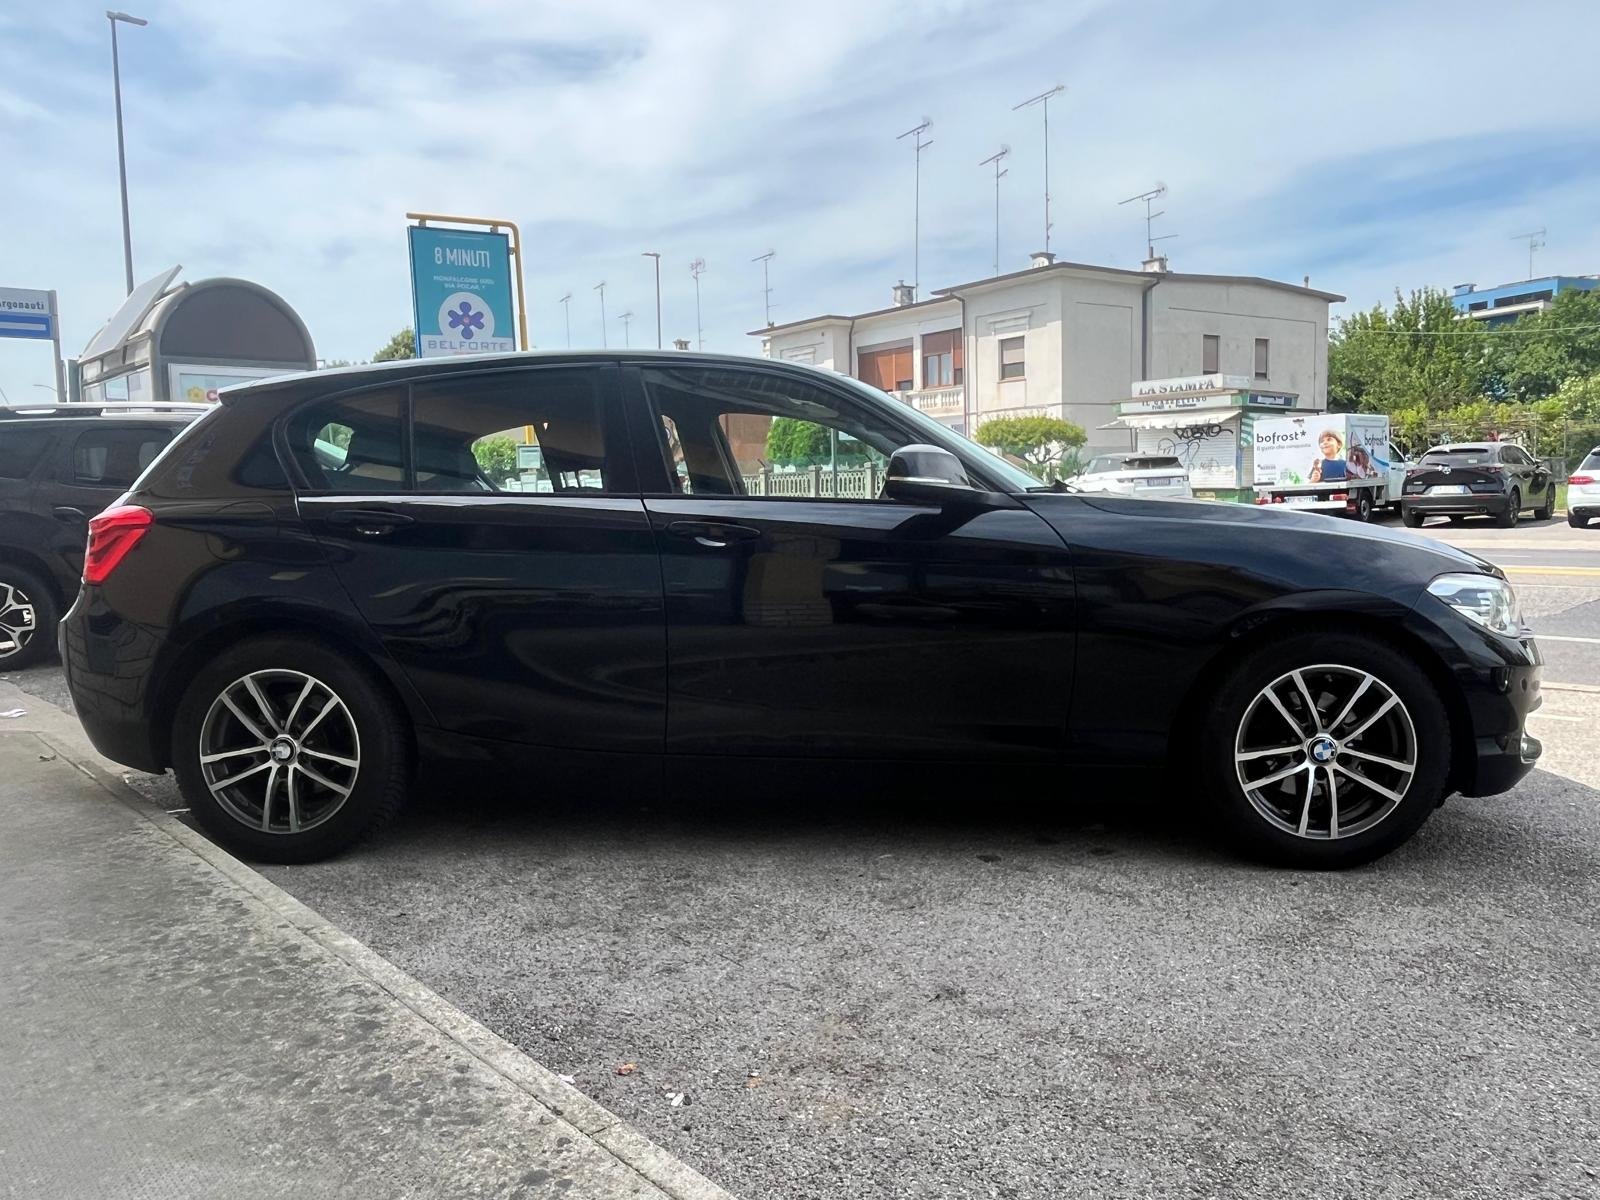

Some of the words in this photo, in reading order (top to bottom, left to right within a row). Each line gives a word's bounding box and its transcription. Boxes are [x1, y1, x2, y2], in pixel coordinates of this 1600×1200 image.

[435, 247, 443, 264] 8
[446, 248, 489, 268] MINUTI
[0, 300, 45, 310] rgonauti
[427, 340, 510, 352] BELFORTE
